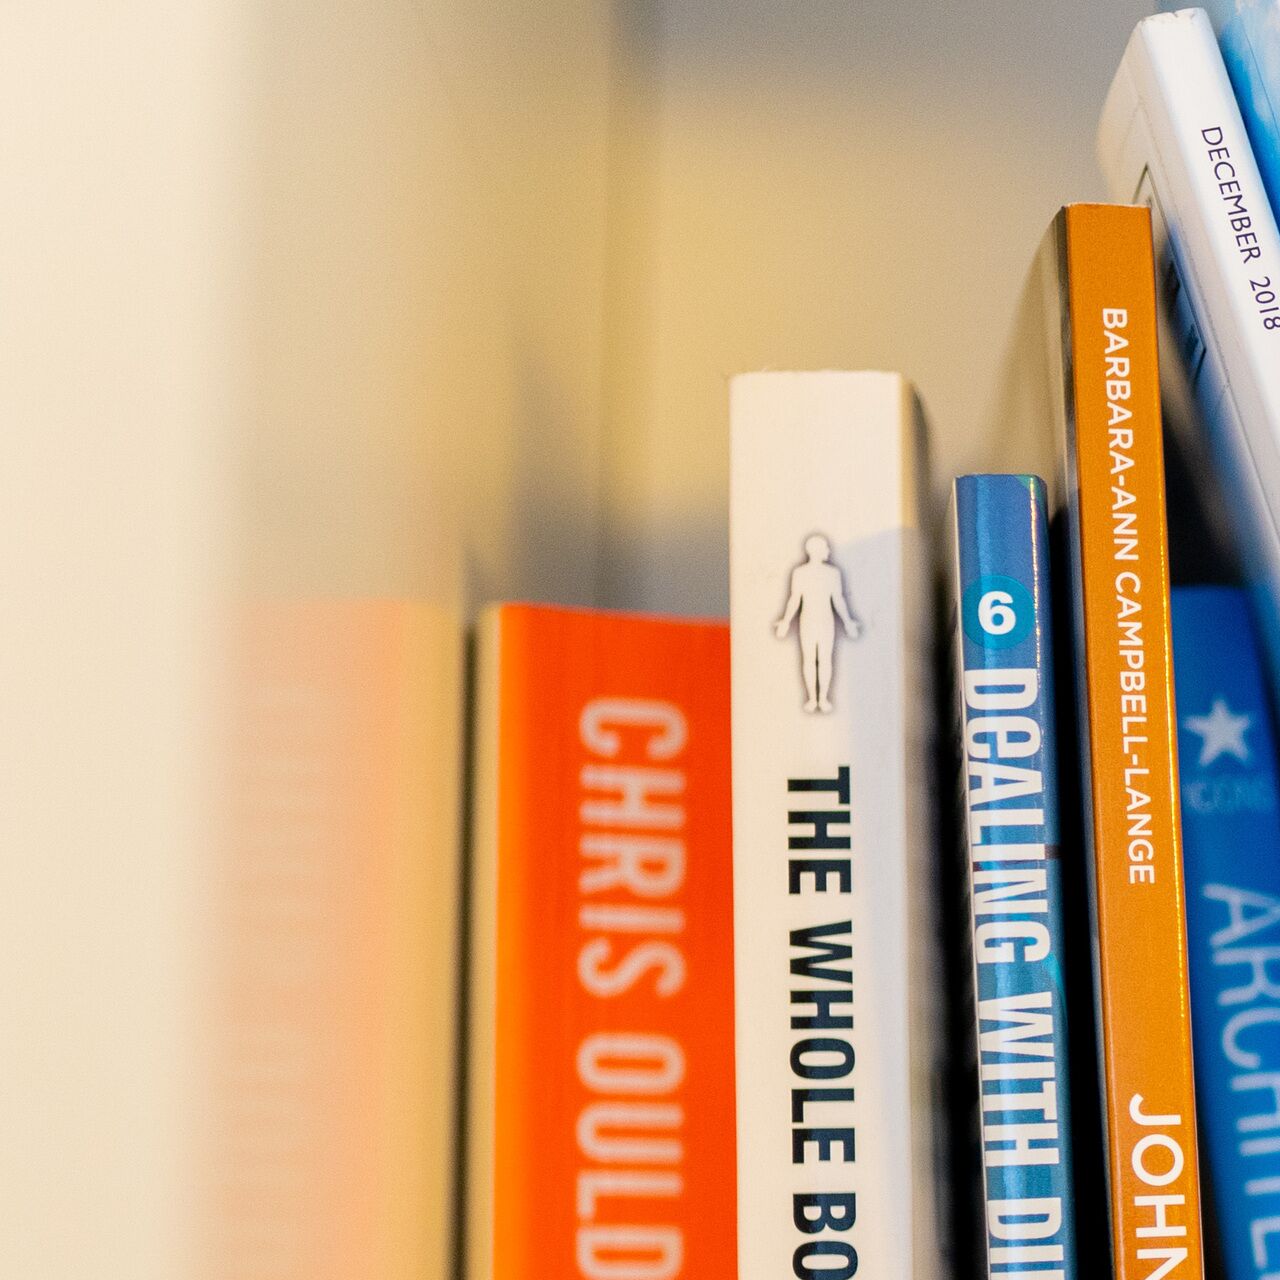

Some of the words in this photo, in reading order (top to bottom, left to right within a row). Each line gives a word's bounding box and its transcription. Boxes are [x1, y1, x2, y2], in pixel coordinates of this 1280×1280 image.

[1201, 126, 1261, 264] DECEMBER
[1101, 306, 1140, 561] BARBARA-ANN
[976, 591, 1017, 636] 6
[786, 766, 851, 895] THE
[1112, 570, 1157, 885] CAMPBELL-LANGE
[578, 697, 689, 998] CHRIS
[788, 920, 856, 1164] WHOLE
[975, 990, 1060, 1168] WITH
